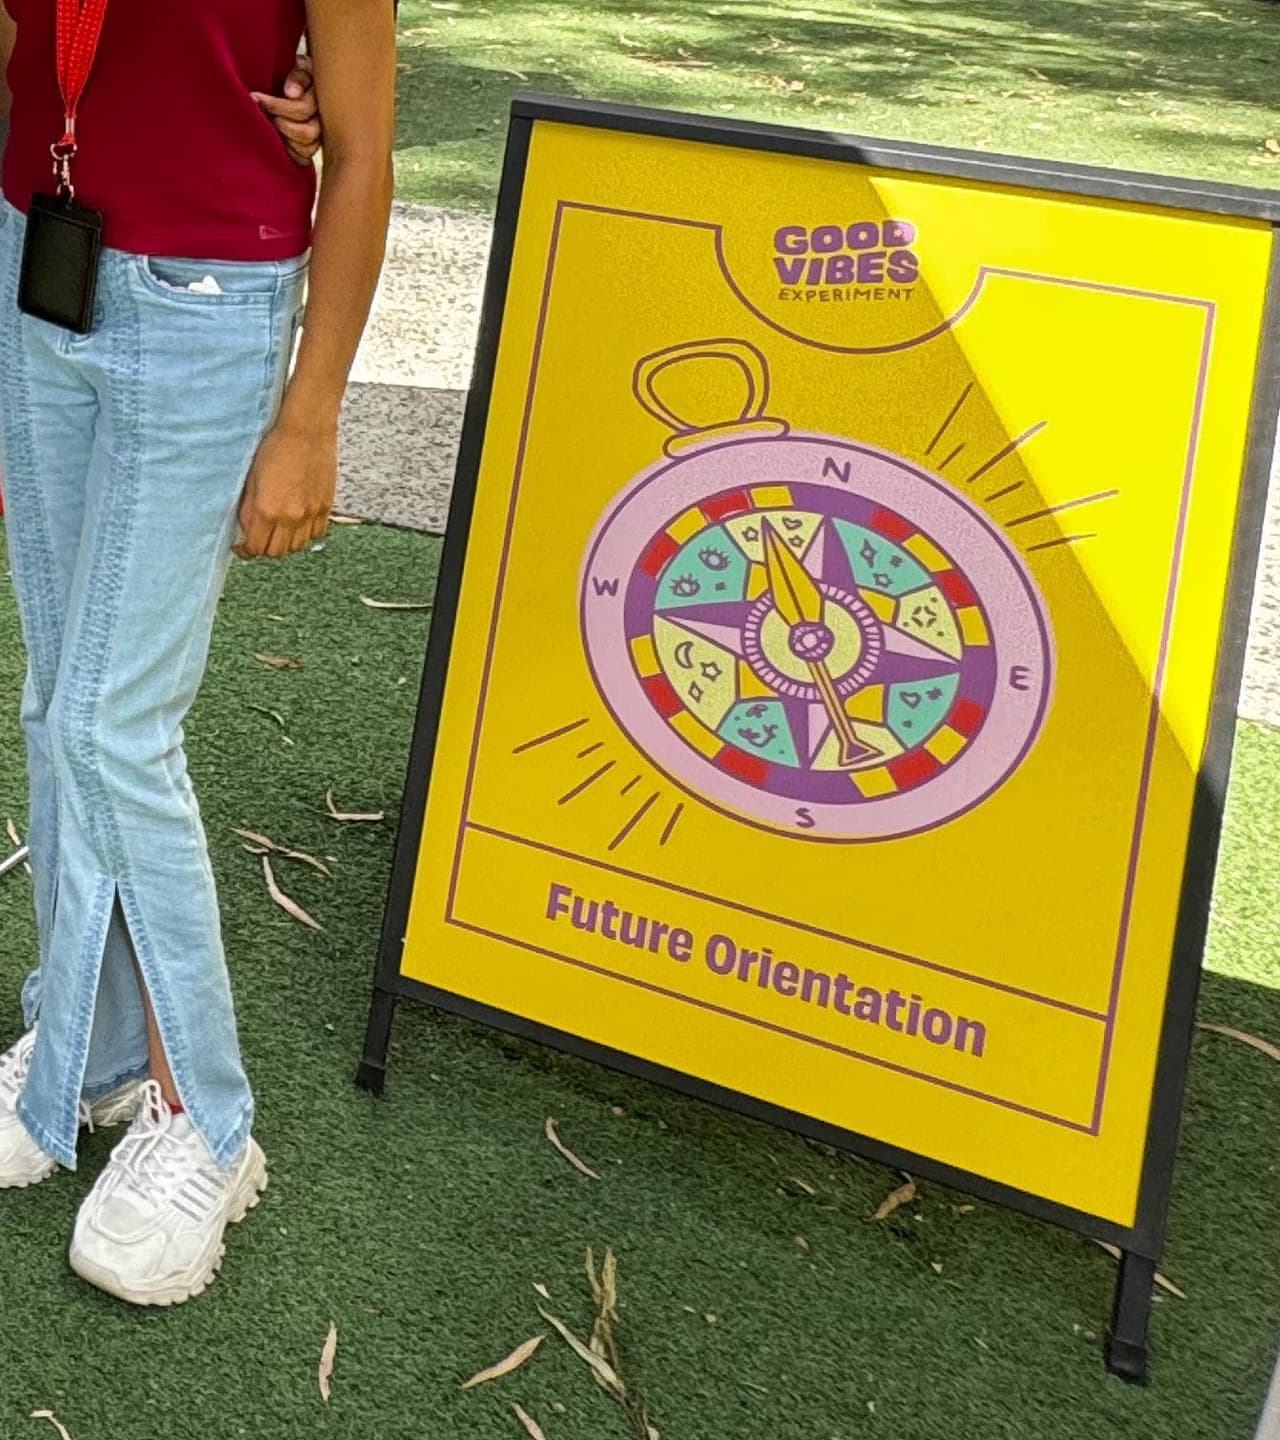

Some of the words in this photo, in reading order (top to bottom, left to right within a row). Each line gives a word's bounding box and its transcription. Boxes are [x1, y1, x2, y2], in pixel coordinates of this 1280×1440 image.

[773, 219, 916, 255] GOOD
[773, 249, 920, 286] VIBES
[778, 287, 916, 303] EXPERIMENT
[821, 456, 851, 483] N
[592, 576, 620, 596] W
[1008, 664, 1031, 690] E
[794, 807, 816, 829] S
[544, 881, 694, 963] Future
[704, 933, 988, 1058] Orientation
